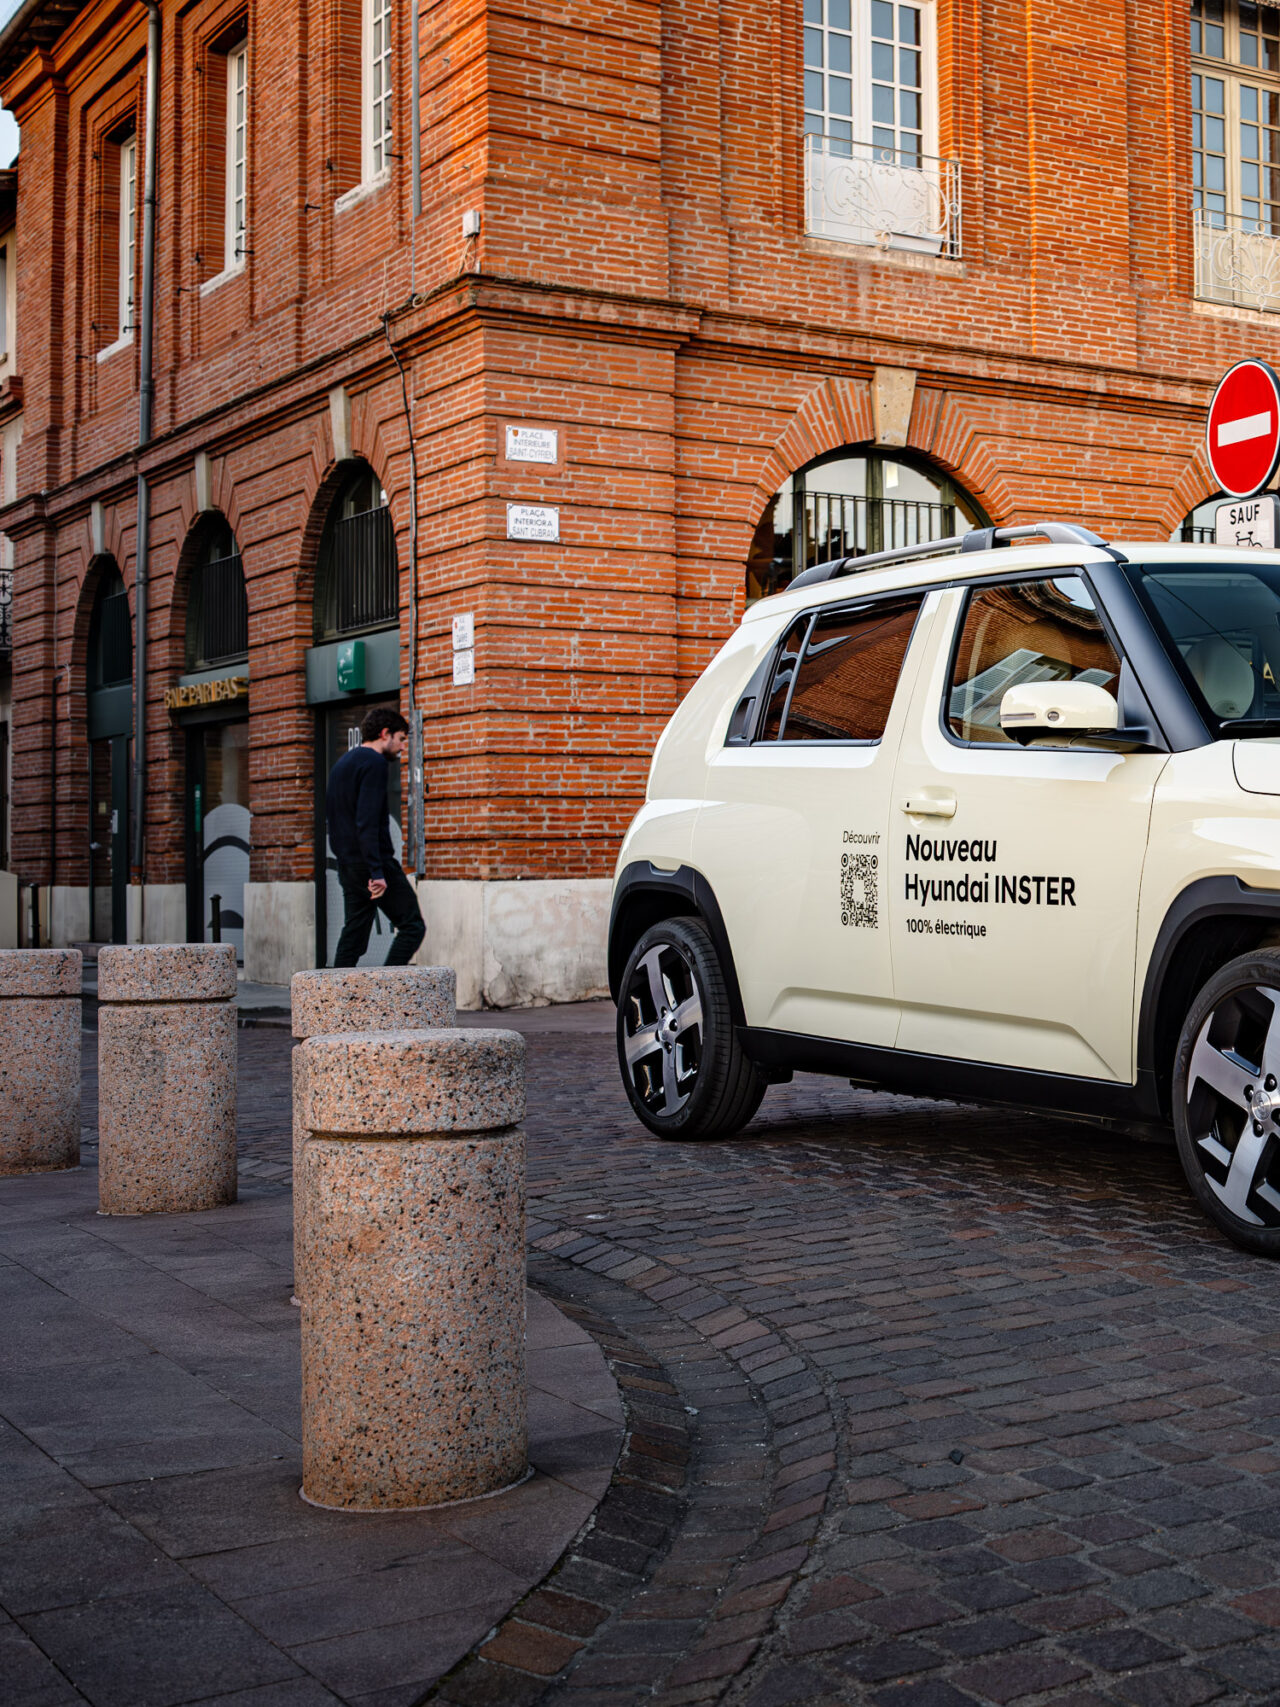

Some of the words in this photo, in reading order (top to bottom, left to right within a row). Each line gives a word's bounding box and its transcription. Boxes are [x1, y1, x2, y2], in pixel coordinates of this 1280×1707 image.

[521, 431, 544, 439] PLACE
[514, 517, 552, 527] INTERIORA
[1230, 504, 1260, 525] SAUF
[189, 677, 239, 706] PARIBAS
[842, 830, 880, 845] Découvrir
[905, 834, 997, 862] Nouveau
[905, 872, 989, 907] Hyundai
[995, 875, 1076, 906] INSTER
[906, 919, 933, 934] 100%
[935, 918, 987, 939] électrique
